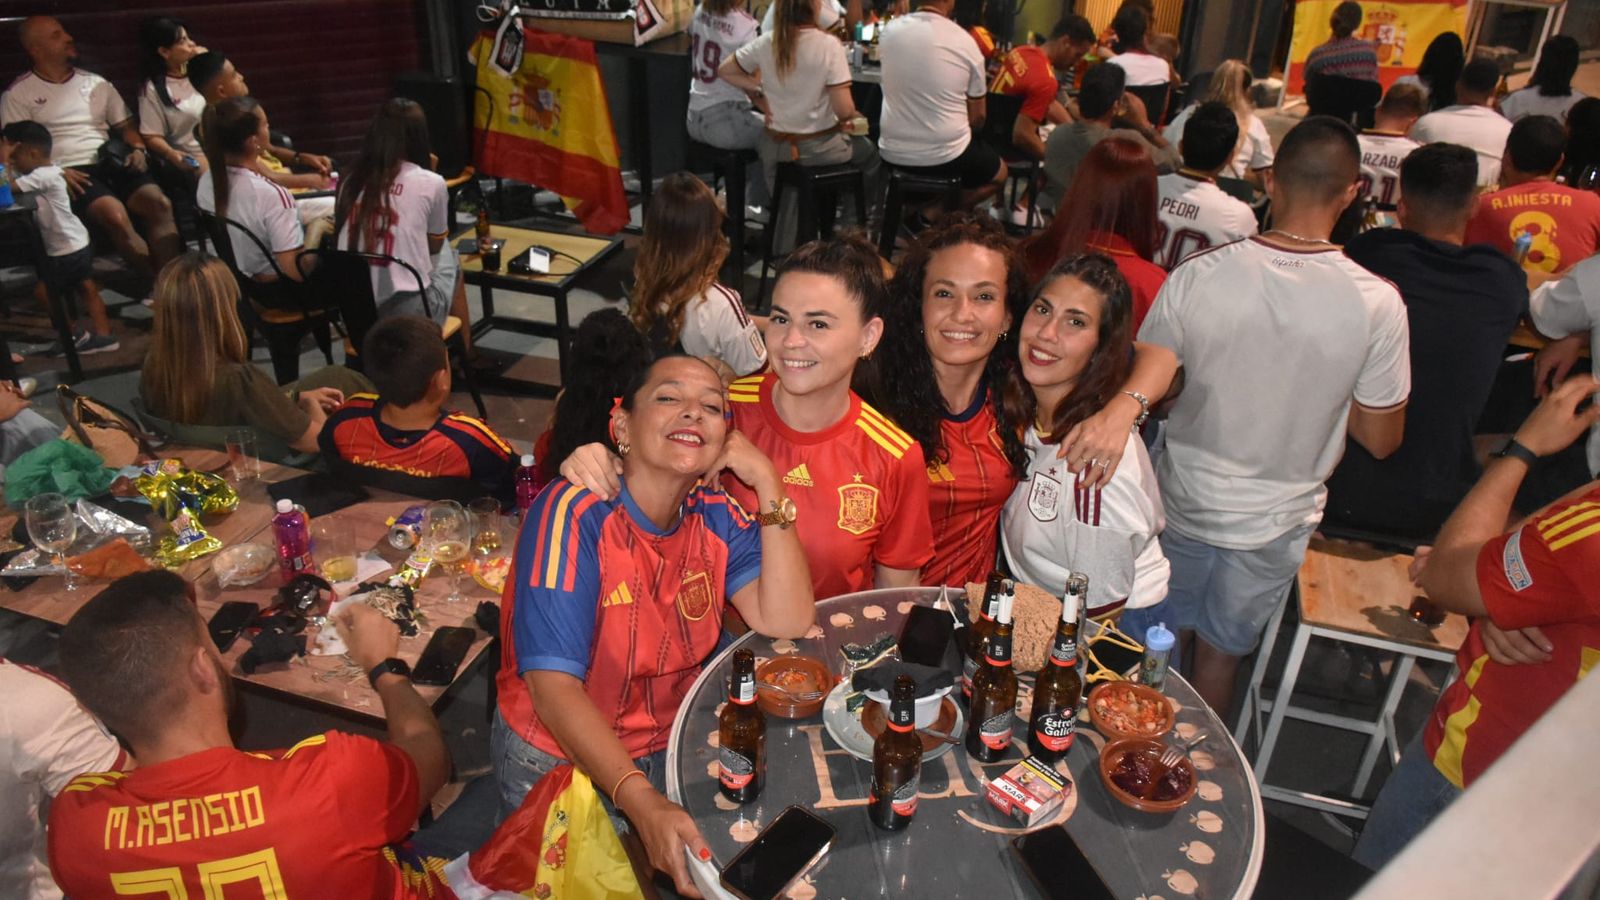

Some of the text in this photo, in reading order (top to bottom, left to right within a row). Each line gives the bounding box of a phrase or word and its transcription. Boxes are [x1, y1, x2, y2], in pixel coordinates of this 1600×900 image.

[1160, 197, 1201, 221] PEDRI
[1492, 193, 1572, 210] A.INIESTA
[782, 476, 814, 487] adidas
[104, 785, 266, 850] M.ASENSIO
